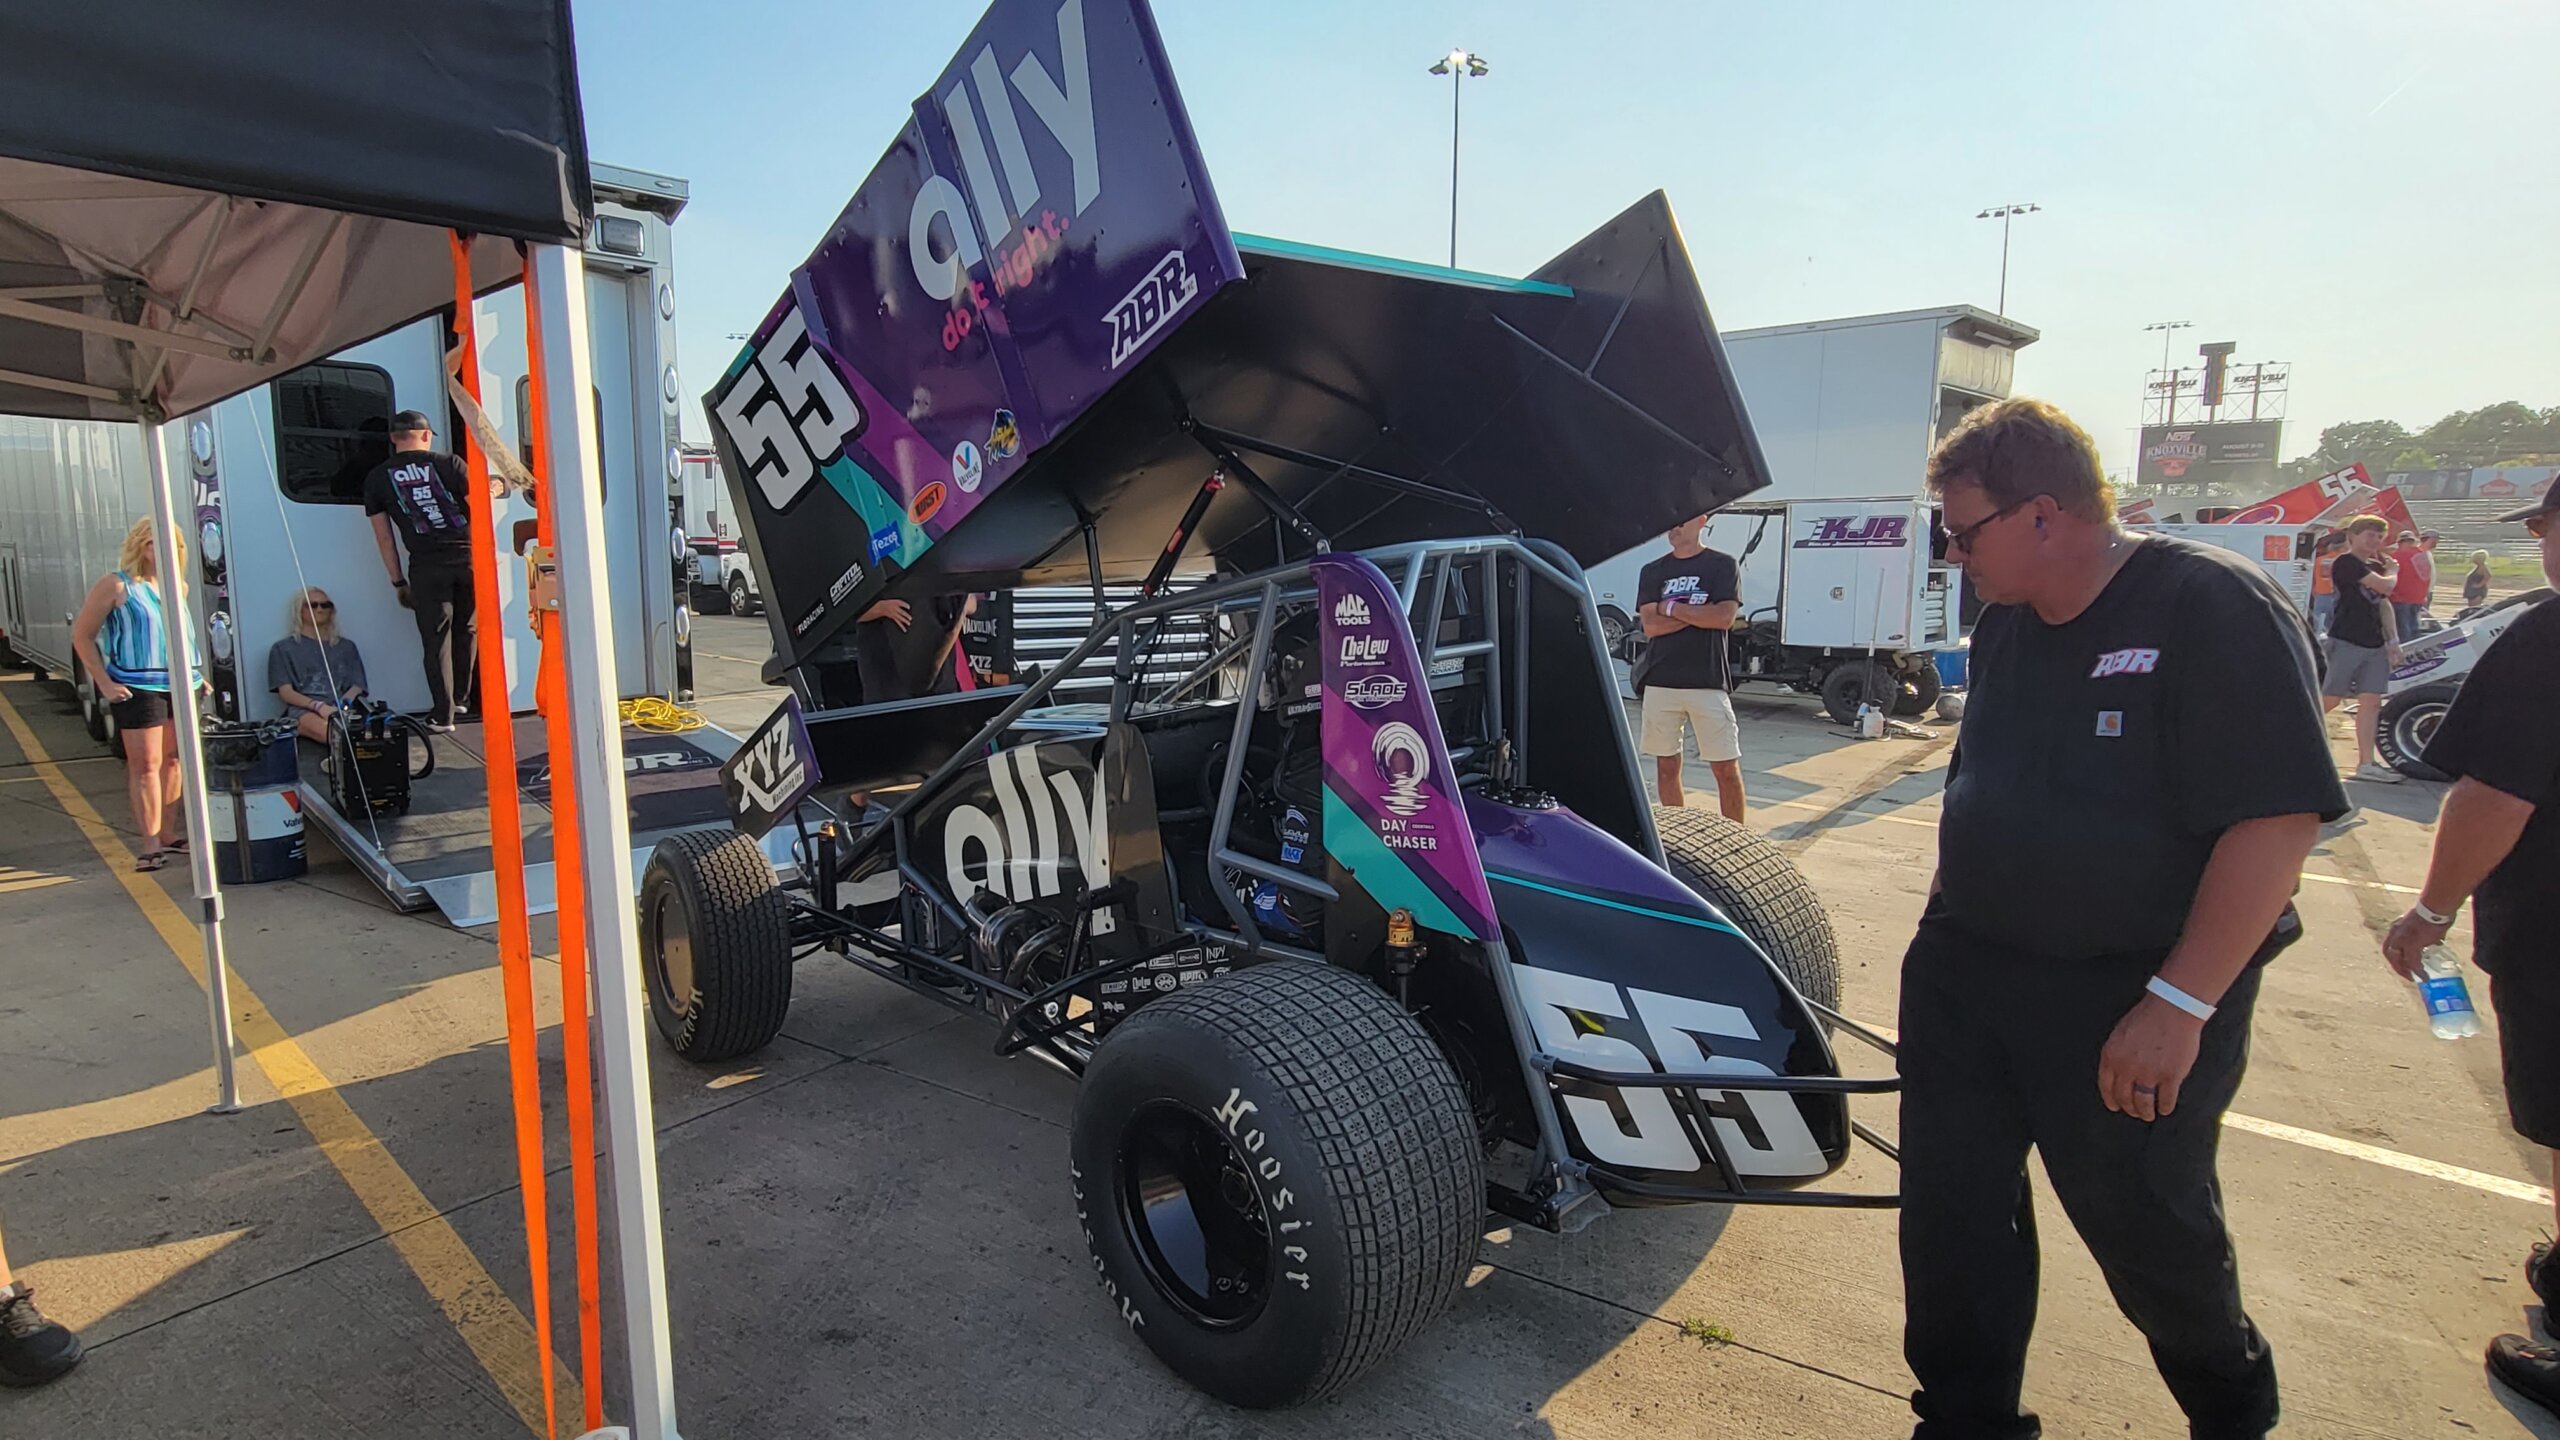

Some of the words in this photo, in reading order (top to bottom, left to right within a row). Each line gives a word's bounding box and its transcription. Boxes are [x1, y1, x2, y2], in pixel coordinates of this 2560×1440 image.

[908, 0, 1101, 301] ally
[942, 308, 972, 351] do
[994, 208, 1070, 297] right.
[1102, 250, 1186, 369] ABR
[715, 305, 860, 510] 55
[2146, 443, 2207, 459] KNOXVILLE
[394, 463, 430, 482] ally
[2318, 467, 2362, 498] 56
[412, 486, 432, 500] 55
[1817, 515, 1909, 540] KJR
[830, 562, 861, 598] CAPITOL
[1664, 576, 1700, 595] ABR
[1335, 594, 1370, 617] MAC
[1689, 593, 1709, 605] 55
[962, 618, 998, 638] VALVOLINE
[1335, 616, 1371, 626] TOOLS
[1341, 635, 1389, 661] ChaLew
[968, 655, 993, 674] XYZ
[2089, 648, 2160, 678] ABR
[1346, 681, 1407, 697] SLADE
[733, 712, 797, 814] XYZ
[1381, 819, 1407, 832] DAY
[944, 741, 1116, 937] ally
[1383, 834, 1438, 850] CHASER
[1511, 962, 1829, 1177] 55
[1212, 1088, 1313, 1290] Hoosier
